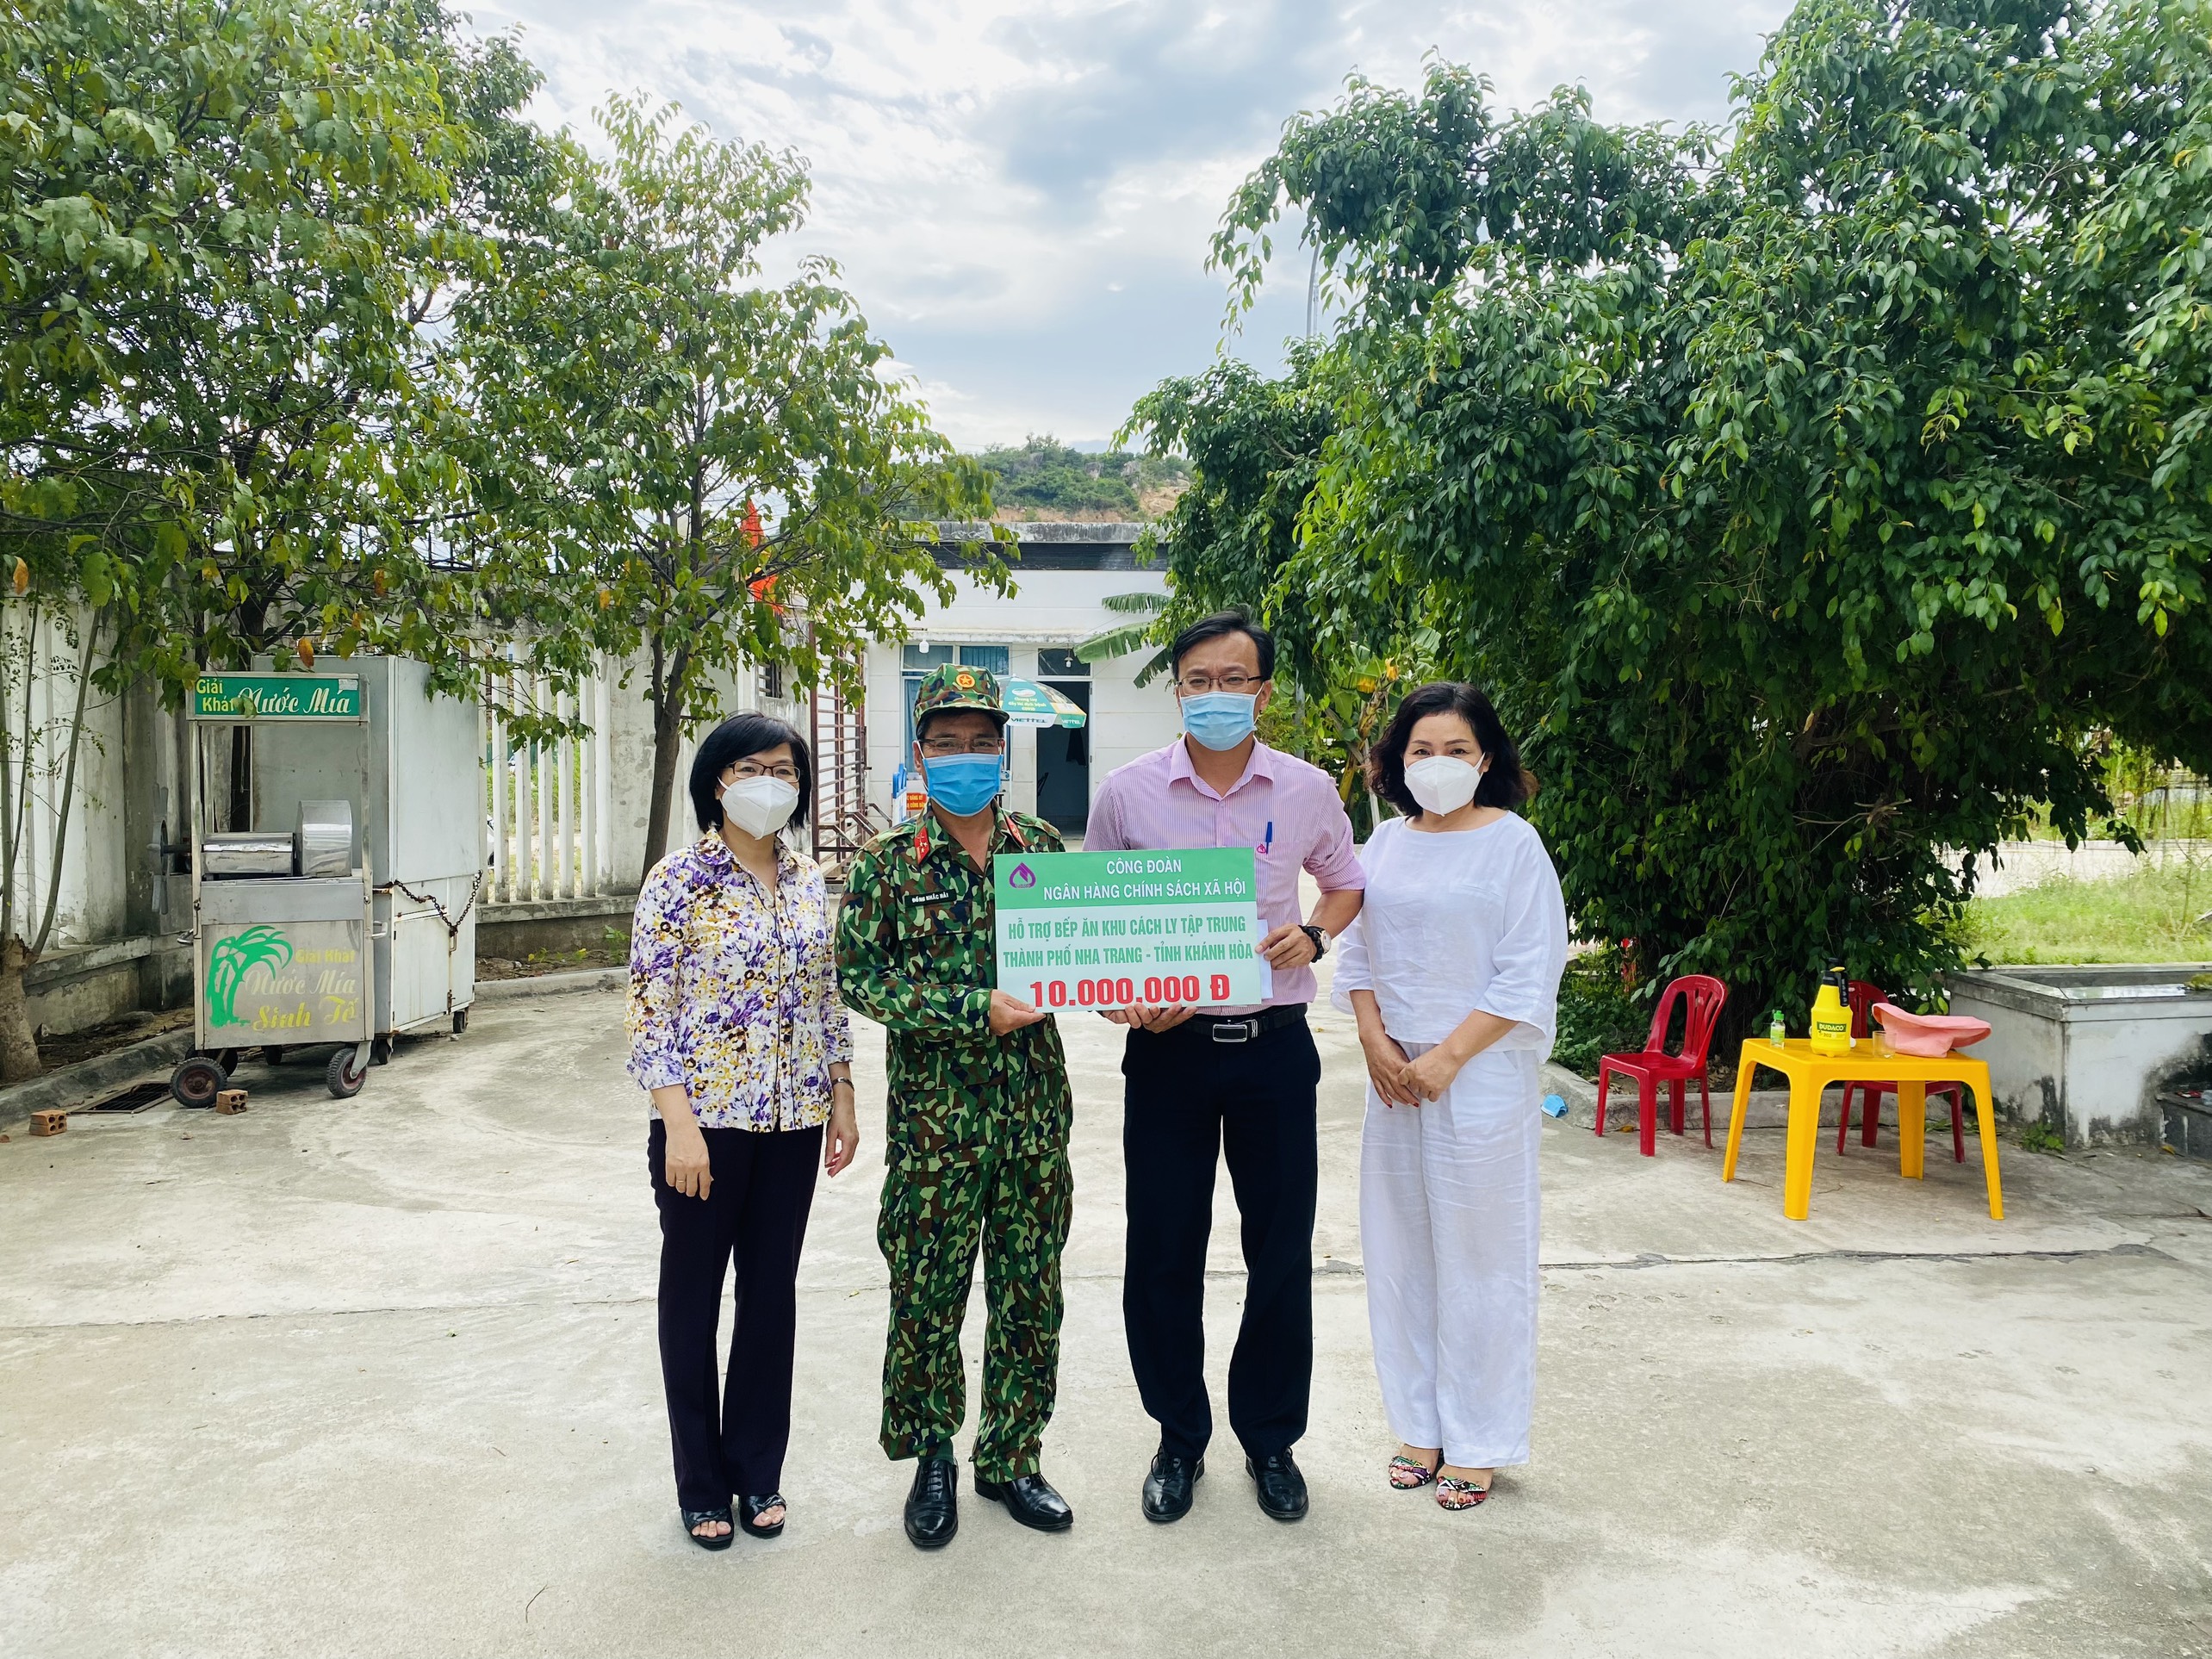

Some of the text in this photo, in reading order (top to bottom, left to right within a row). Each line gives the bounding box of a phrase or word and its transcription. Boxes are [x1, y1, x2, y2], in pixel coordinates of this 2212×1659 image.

[196, 679, 223, 694] Giải
[202, 695, 234, 711] Khát
[238, 687, 351, 714] Nước Mía
[1106, 857, 1182, 875] CÔNG ĐOÀN
[1043, 877, 1246, 900] NGÂN HÀNG CHÍNH SÁCH XÃ HỘI
[1008, 914, 1246, 941] HỖ TRỢ BẾP ĂN KHU CÁCH LY TẬP TRUNG
[1003, 948, 1043, 967] THÀNH
[1047, 943, 1072, 966] PHỐ
[1074, 948, 1101, 965] NHA
[1103, 947, 1142, 964] TRANG
[1153, 941, 1182, 962] TỈNH
[1184, 941, 1226, 961] KHÁNH
[1228, 939, 1253, 960] HÒA
[310, 970, 357, 994] Mía
[1029, 974, 1231, 1008] 10.000.000 Đ
[252, 1002, 311, 1031] Sinh
[1818, 1022, 1844, 1032] DUDACO
